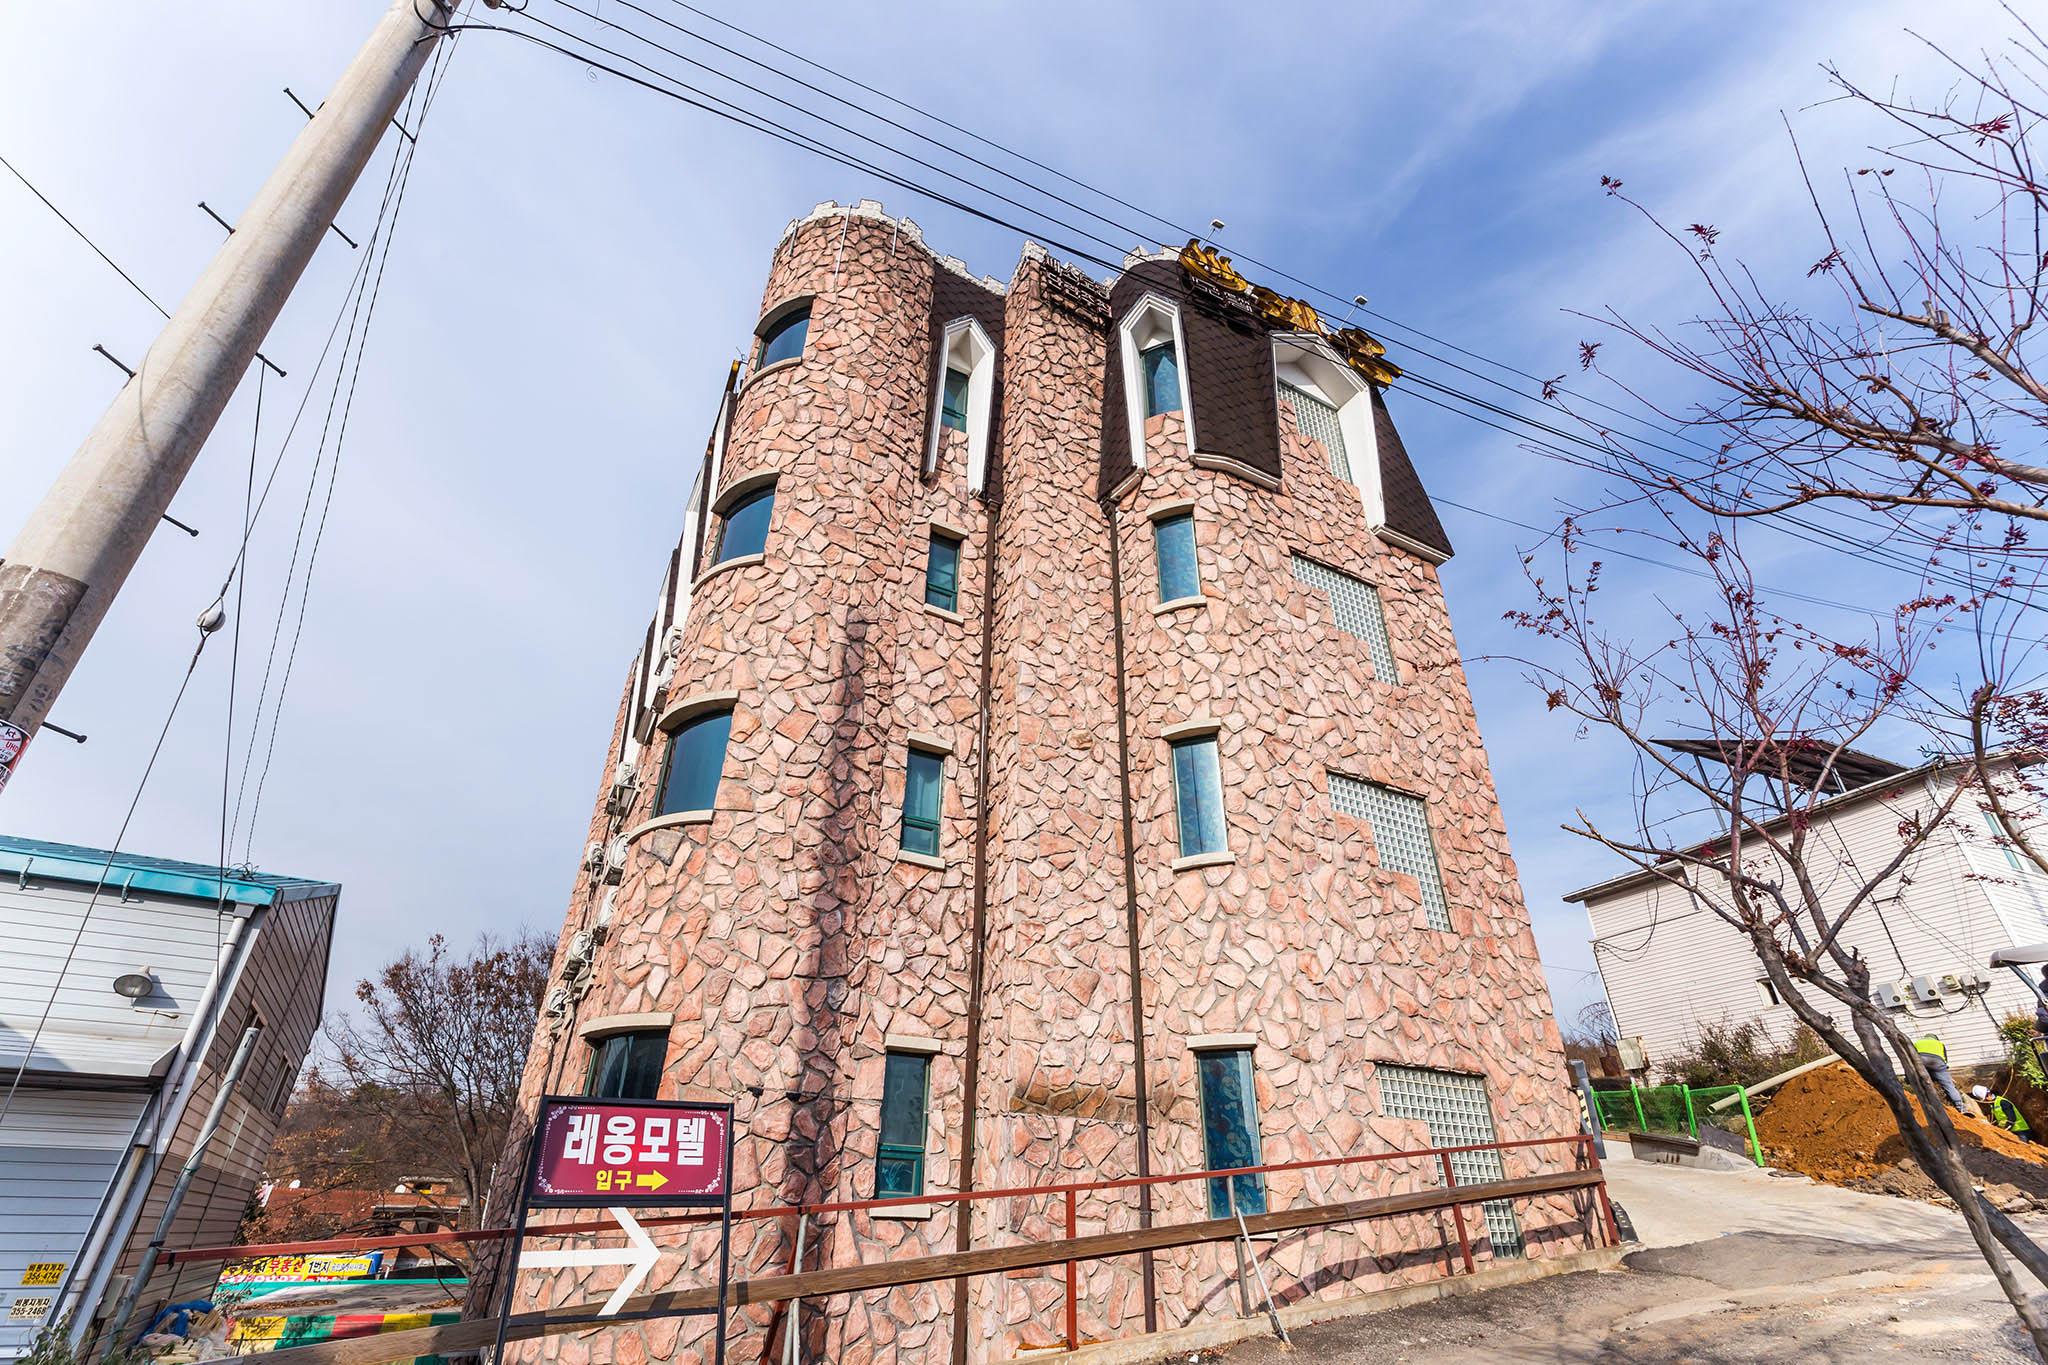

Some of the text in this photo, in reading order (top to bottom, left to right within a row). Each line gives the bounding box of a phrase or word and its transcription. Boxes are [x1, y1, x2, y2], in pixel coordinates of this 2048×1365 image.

[5, 728, 17, 739] kt
[563, 1114, 706, 1165] 레옹모텔
[596, 1170, 632, 1191] 입구
